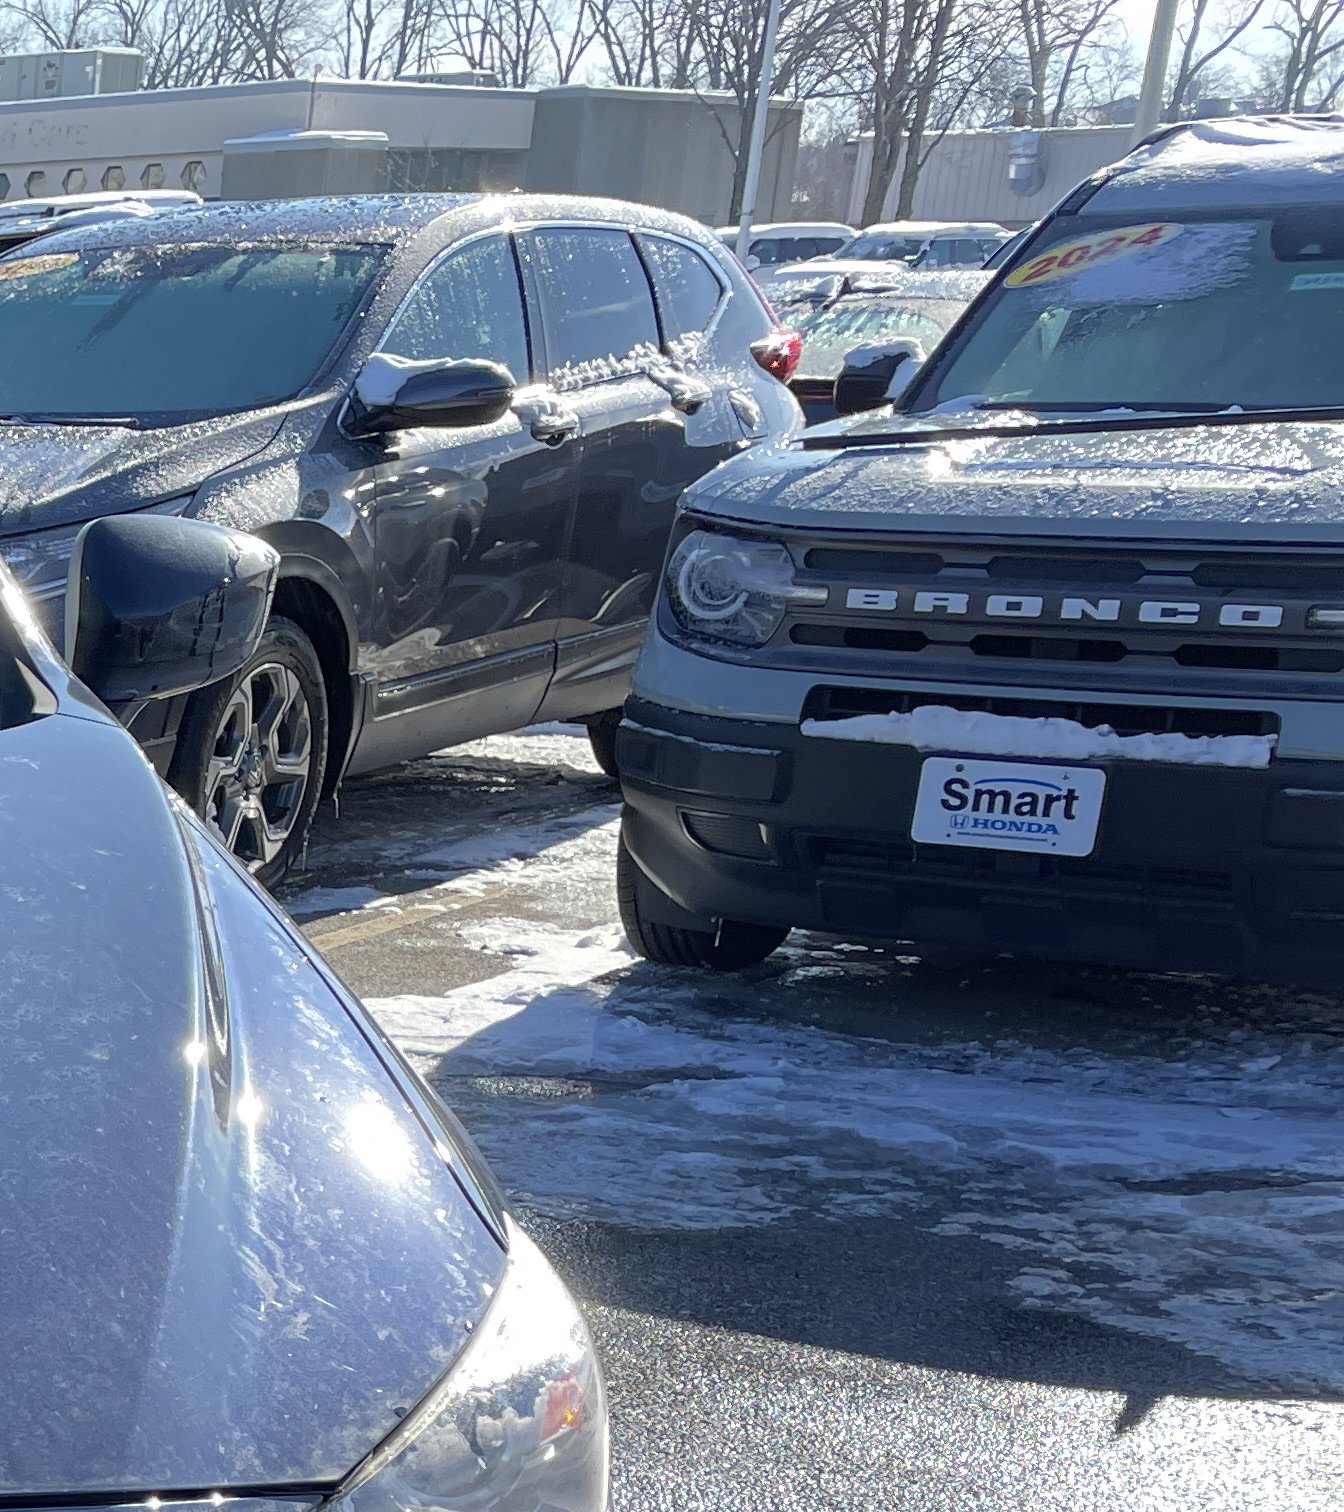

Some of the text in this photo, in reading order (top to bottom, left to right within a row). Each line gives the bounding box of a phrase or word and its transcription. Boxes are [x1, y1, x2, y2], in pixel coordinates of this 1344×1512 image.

[1022, 225, 1164, 282] 2024
[845, 587, 1284, 628] BRONCO
[940, 777, 1080, 820] Smart
[971, 817, 1060, 836] HONDA
